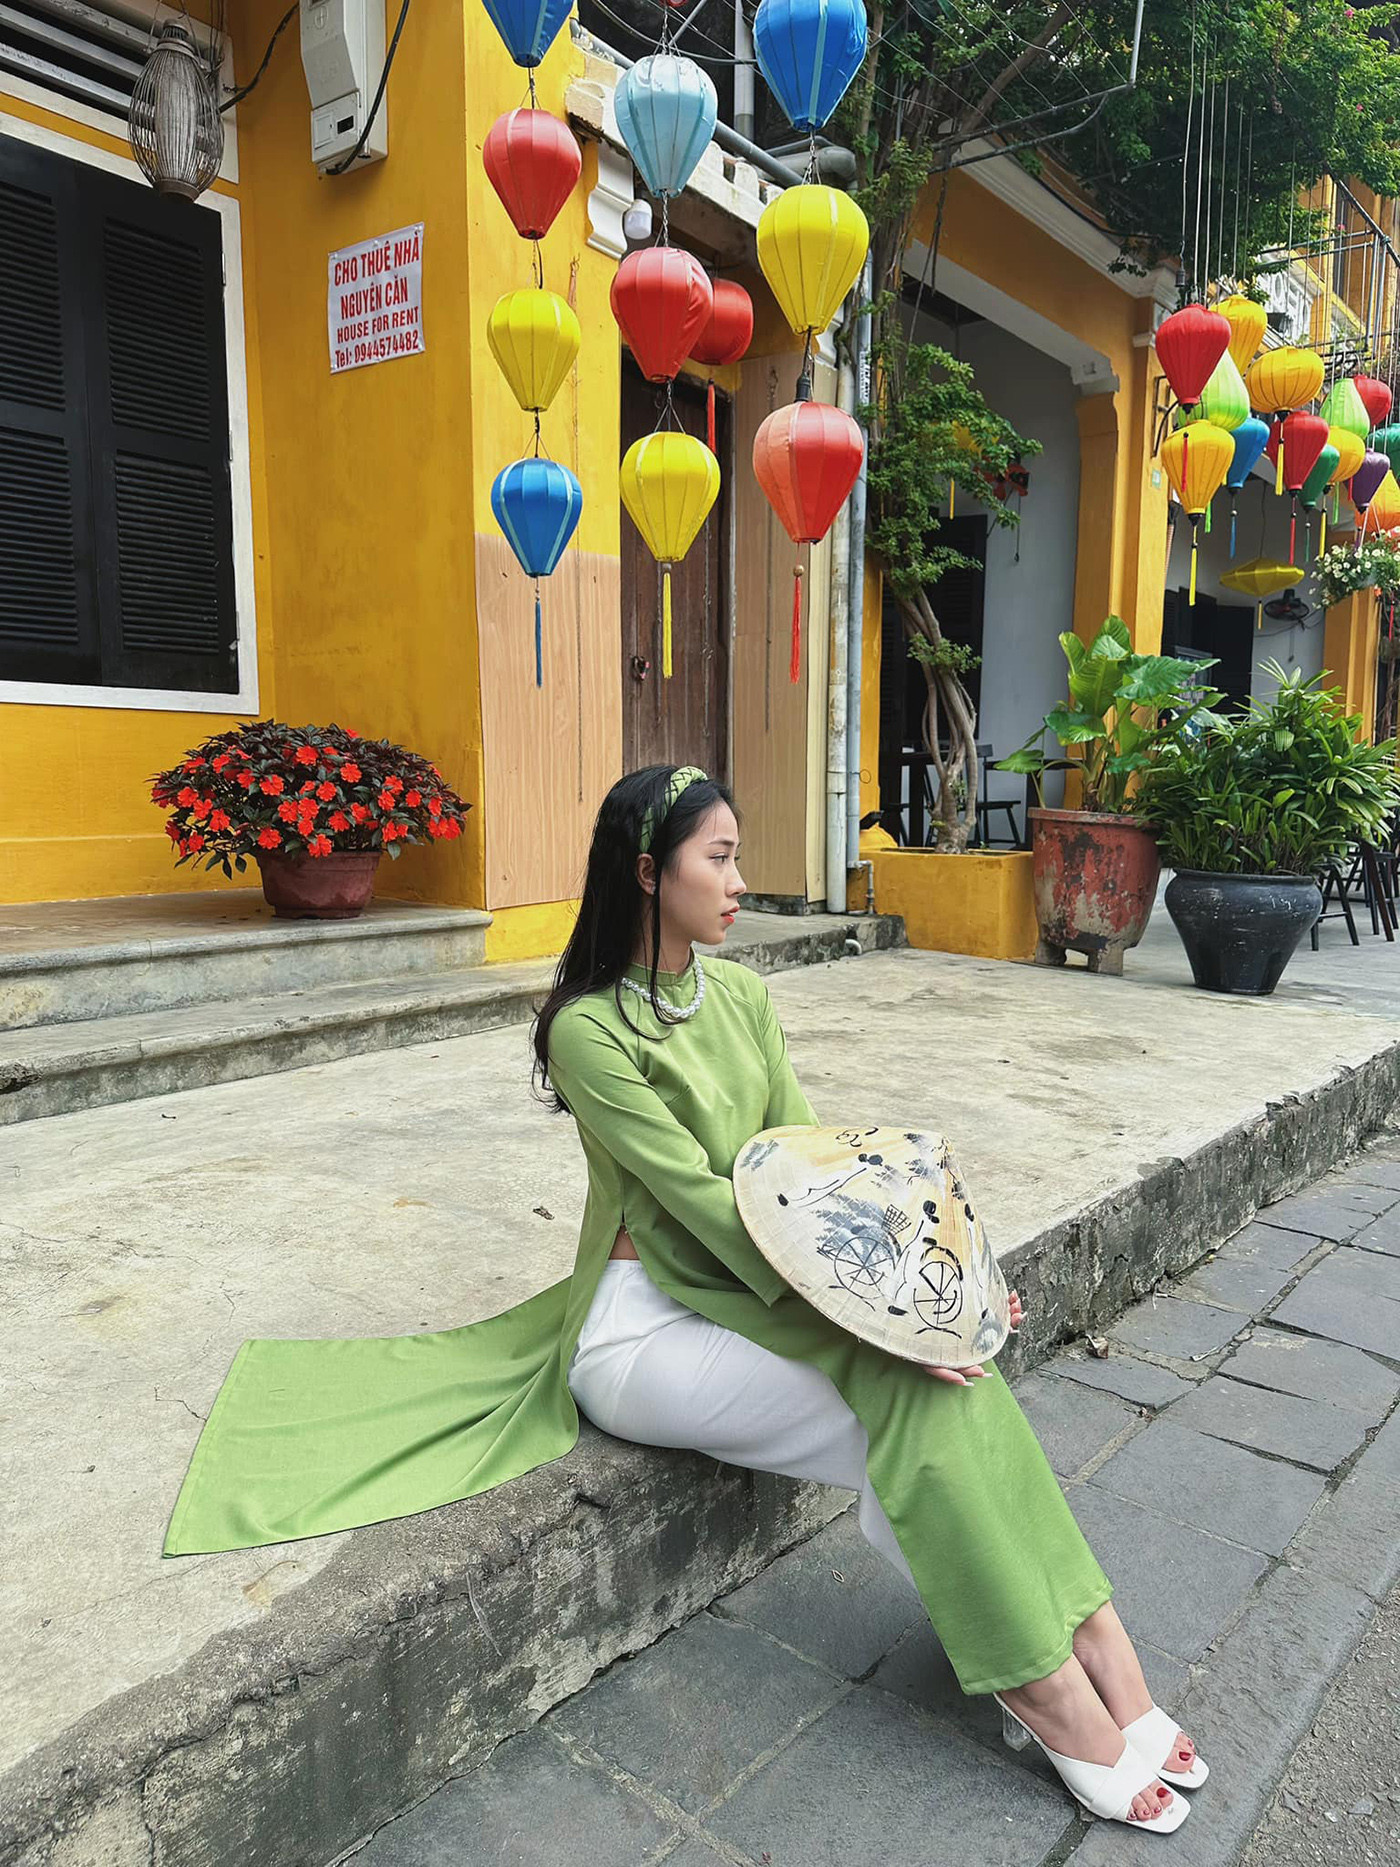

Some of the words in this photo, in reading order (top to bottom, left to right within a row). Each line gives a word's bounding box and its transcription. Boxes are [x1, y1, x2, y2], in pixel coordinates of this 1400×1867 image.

[334, 257, 358, 287] CHO
[361, 241, 391, 278] THUÊ
[394, 230, 420, 268] NHÀ
[340, 282, 382, 320] NGUYÊN
[385, 276, 408, 307] CĂN
[337, 321, 369, 344] HOUSE
[372, 314, 389, 334] FOR
[392, 306, 419, 328] RENT
[335, 348, 352, 369] Tel:
[354, 329, 419, 364] 0944574482
